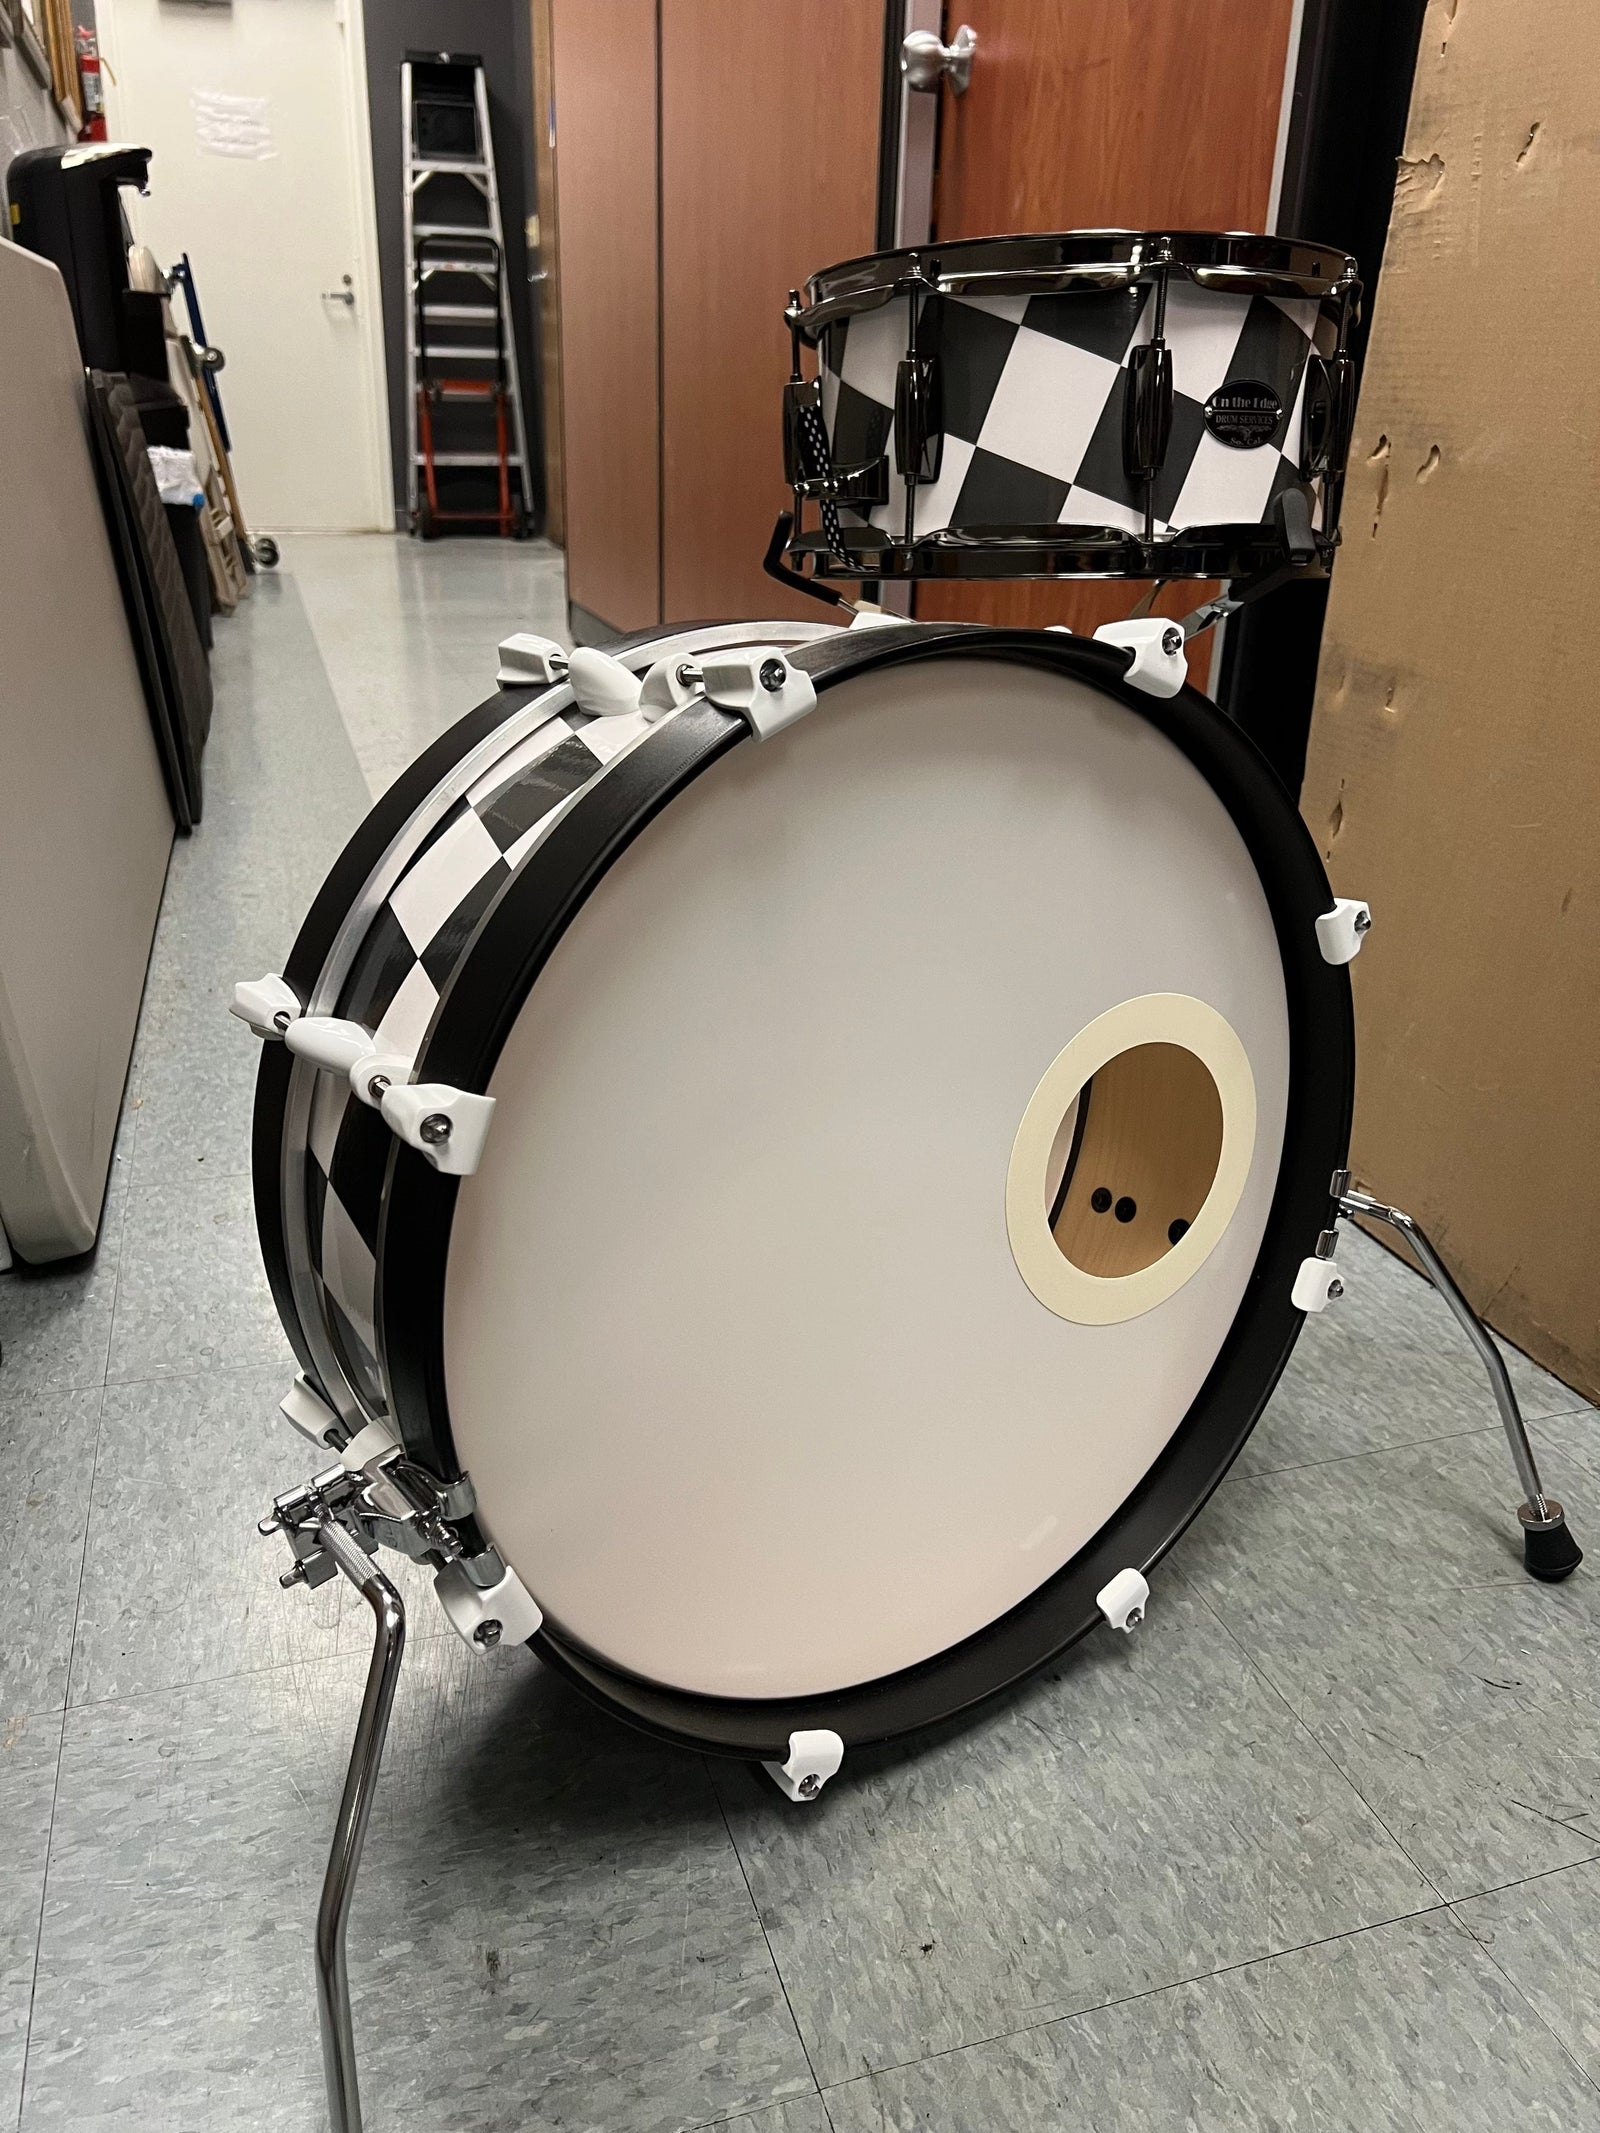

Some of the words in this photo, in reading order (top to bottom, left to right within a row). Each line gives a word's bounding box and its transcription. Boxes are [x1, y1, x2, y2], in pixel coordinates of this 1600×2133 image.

[1212, 396, 1229, 407] On
[1232, 396, 1251, 408] the
[1253, 397, 1278, 409] Edge
[1215, 415, 1238, 424] DRUM
[1239, 414, 1273, 424] SERVICES
